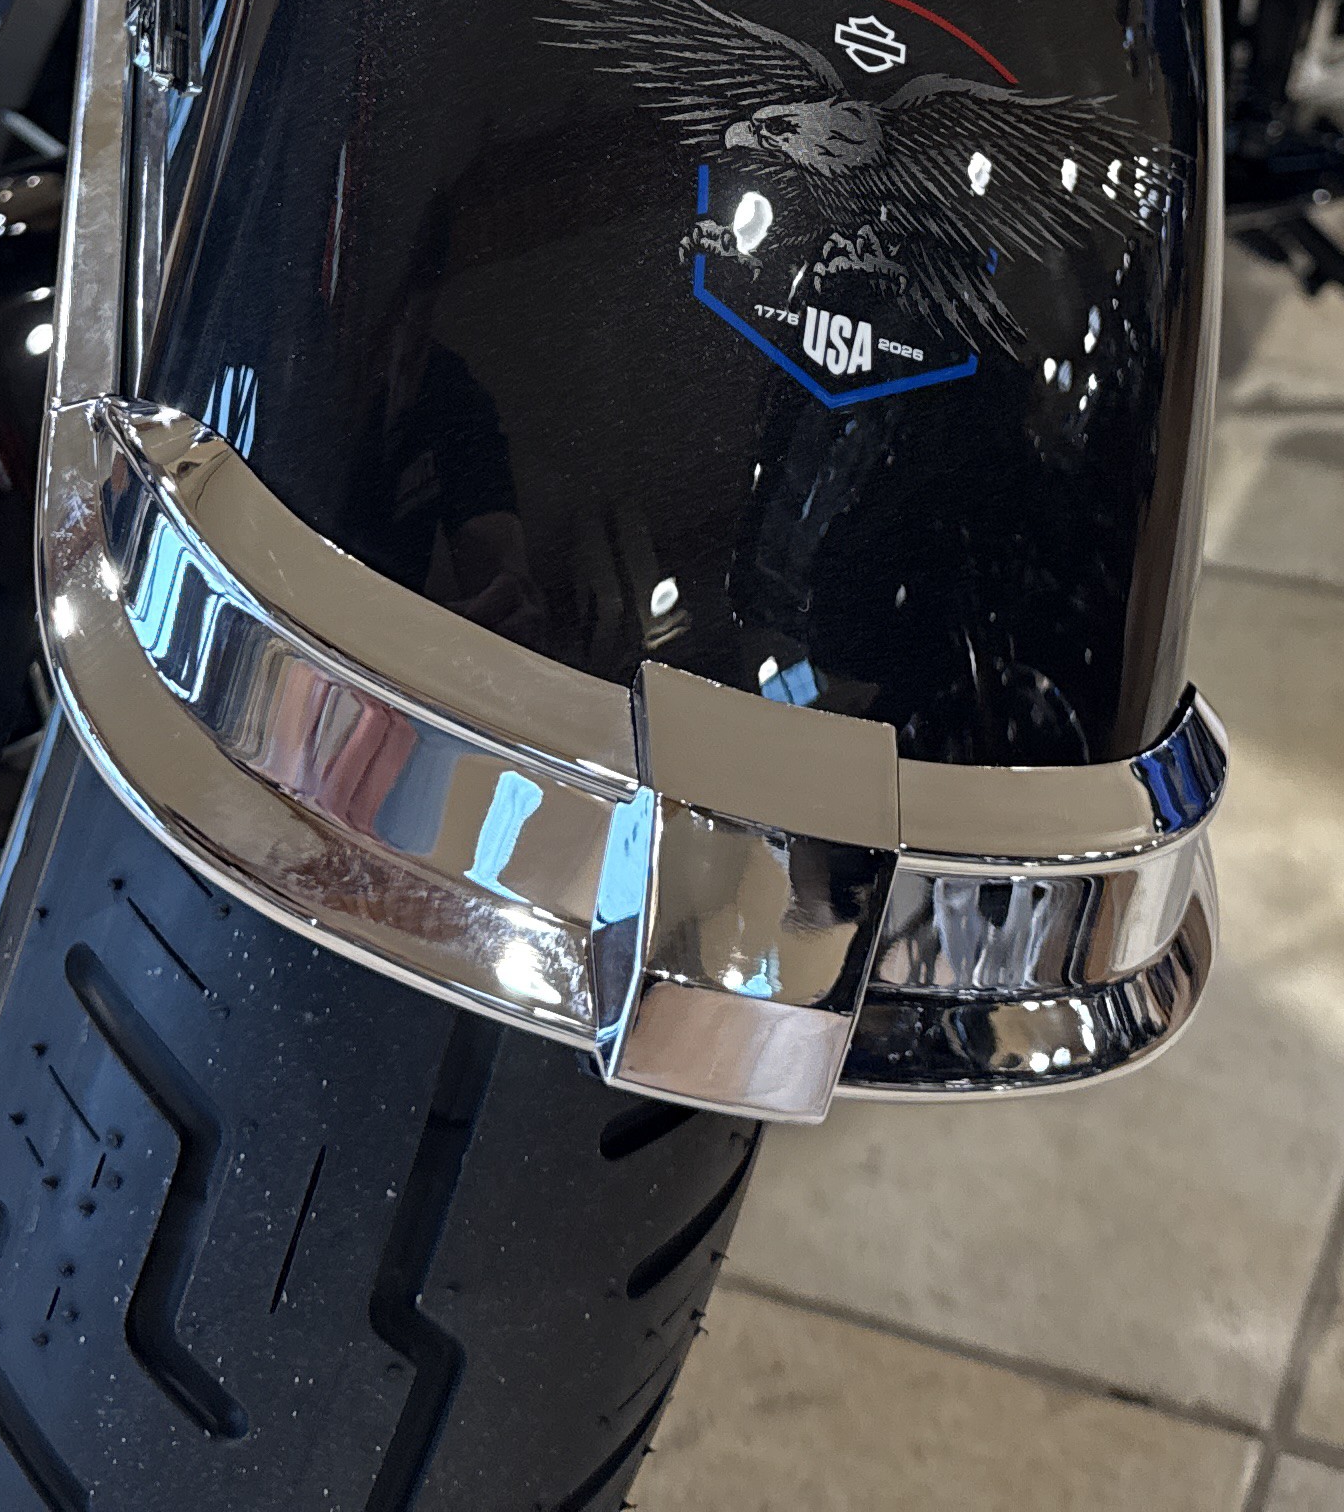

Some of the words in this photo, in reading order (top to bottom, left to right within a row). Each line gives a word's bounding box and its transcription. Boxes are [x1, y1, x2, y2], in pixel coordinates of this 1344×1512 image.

[754, 304, 800, 326] 1776
[803, 305, 872, 376] USA
[877, 338, 924, 362] 2026
